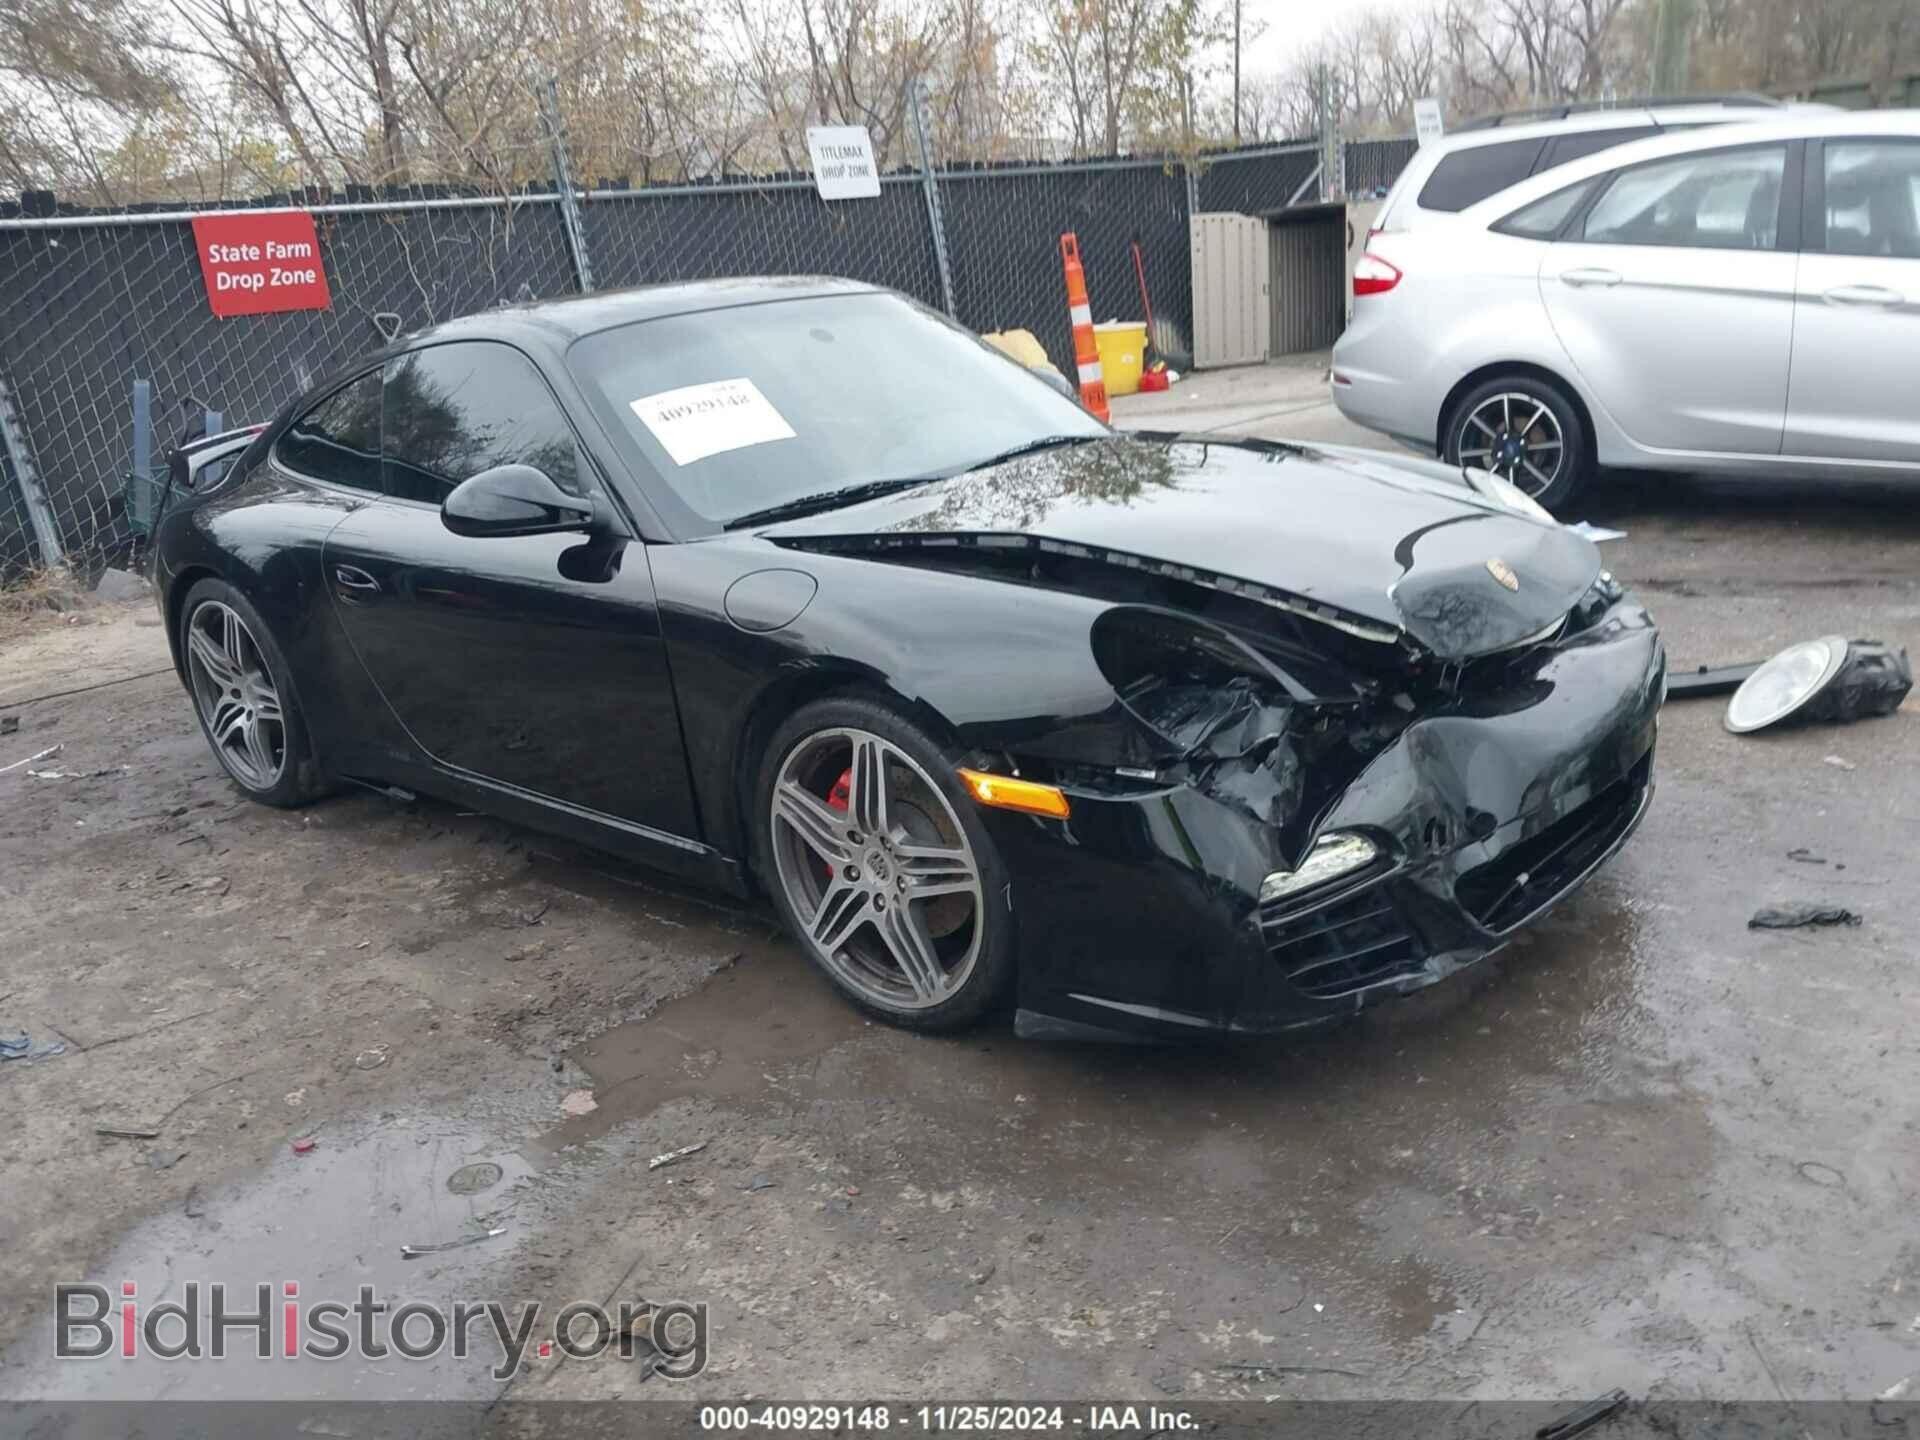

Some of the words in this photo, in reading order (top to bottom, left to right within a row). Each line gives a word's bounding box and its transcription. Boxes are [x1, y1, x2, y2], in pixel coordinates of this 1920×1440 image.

[819, 145, 865, 160] TITLEMAX
[820, 164, 845, 178] DROP
[848, 164, 869, 177] ZONE
[208, 244, 260, 263] State
[266, 241, 311, 259] Farm
[216, 272, 264, 293] Drop
[270, 268, 316, 286] Zone
